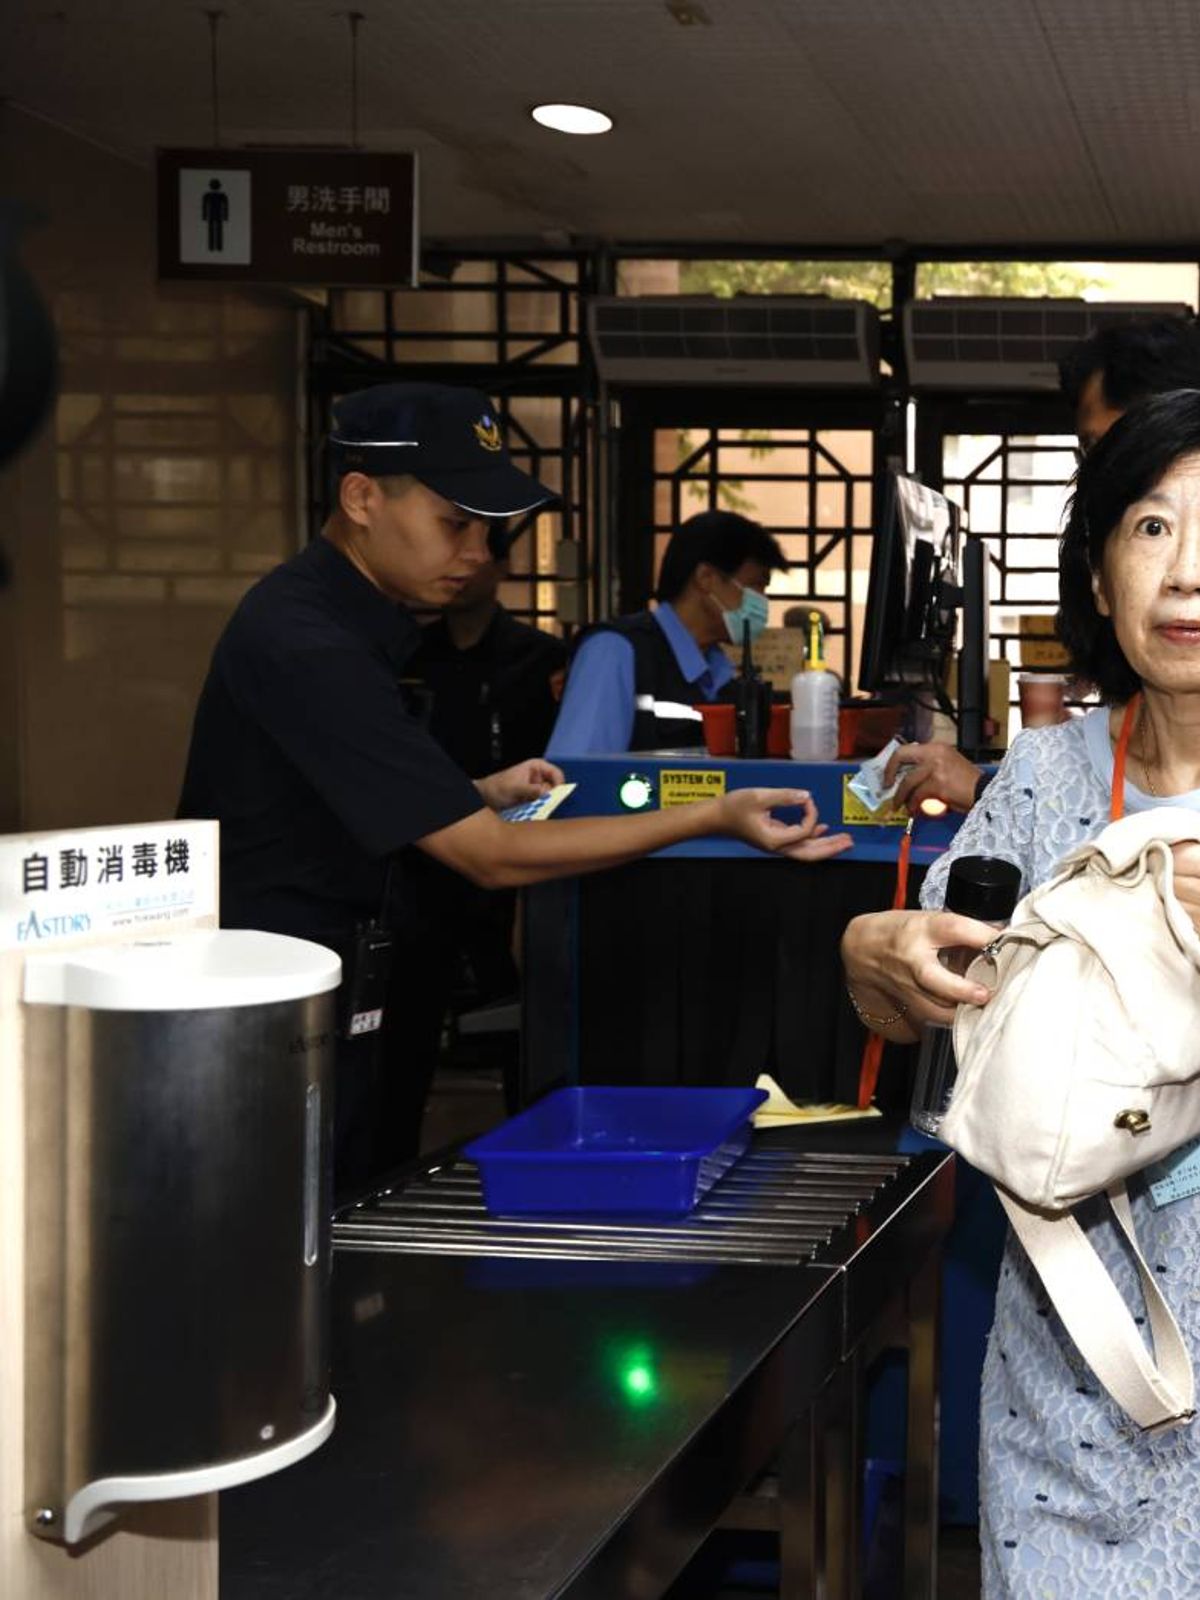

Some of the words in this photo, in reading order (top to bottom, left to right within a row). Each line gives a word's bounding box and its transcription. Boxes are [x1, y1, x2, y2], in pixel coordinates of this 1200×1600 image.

[286, 185, 390, 214] 男洗手間
[310, 221, 363, 239] Men's
[293, 238, 381, 255] Restroom
[662, 773, 704, 784] SYSTEM
[706, 774, 722, 784] ON
[22, 838, 190, 895] 自動消毒機
